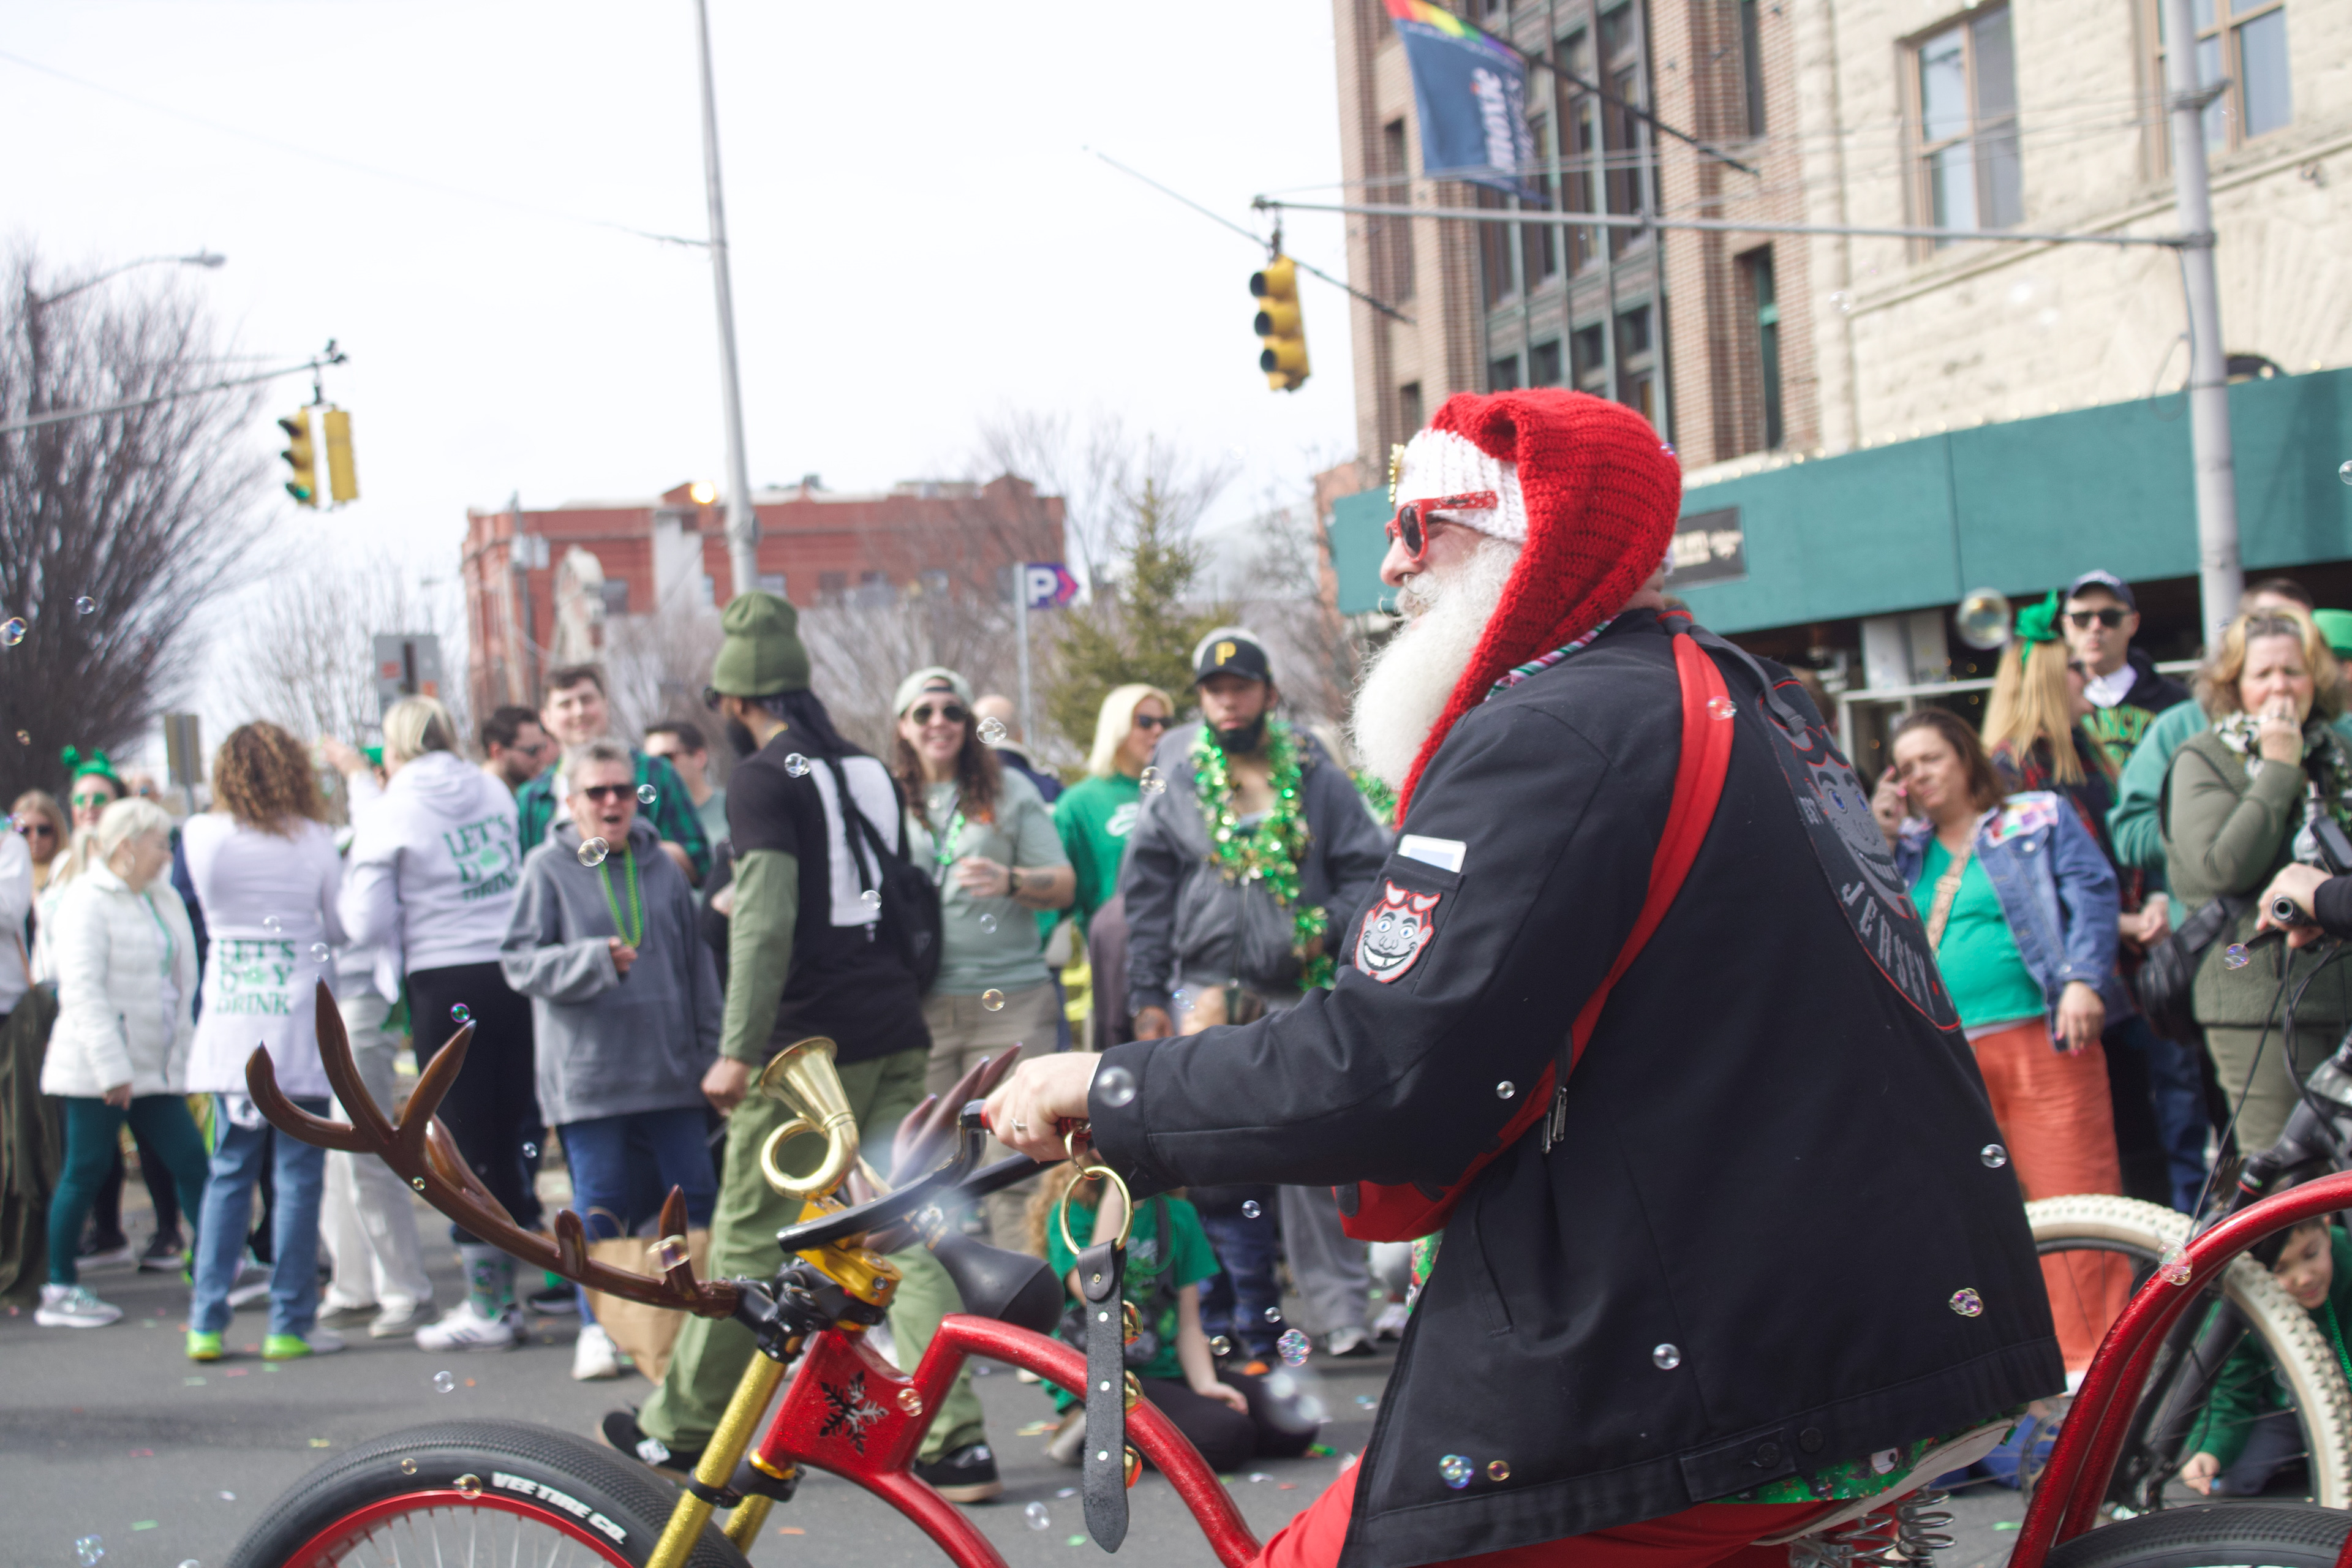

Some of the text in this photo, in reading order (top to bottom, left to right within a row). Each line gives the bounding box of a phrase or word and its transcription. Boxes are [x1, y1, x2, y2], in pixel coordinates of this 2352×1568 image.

[1027, 568, 1058, 604] P
[1215, 642, 1236, 666] P
[443, 813, 511, 857] LET'S
[463, 872, 519, 900] DRIN
[219, 940, 296, 962] LET'S
[1841, 881, 1936, 1017] JERSEY
[216, 992, 290, 1015] DRINK
[492, 1471, 627, 1544] VEE TIRE CO.
